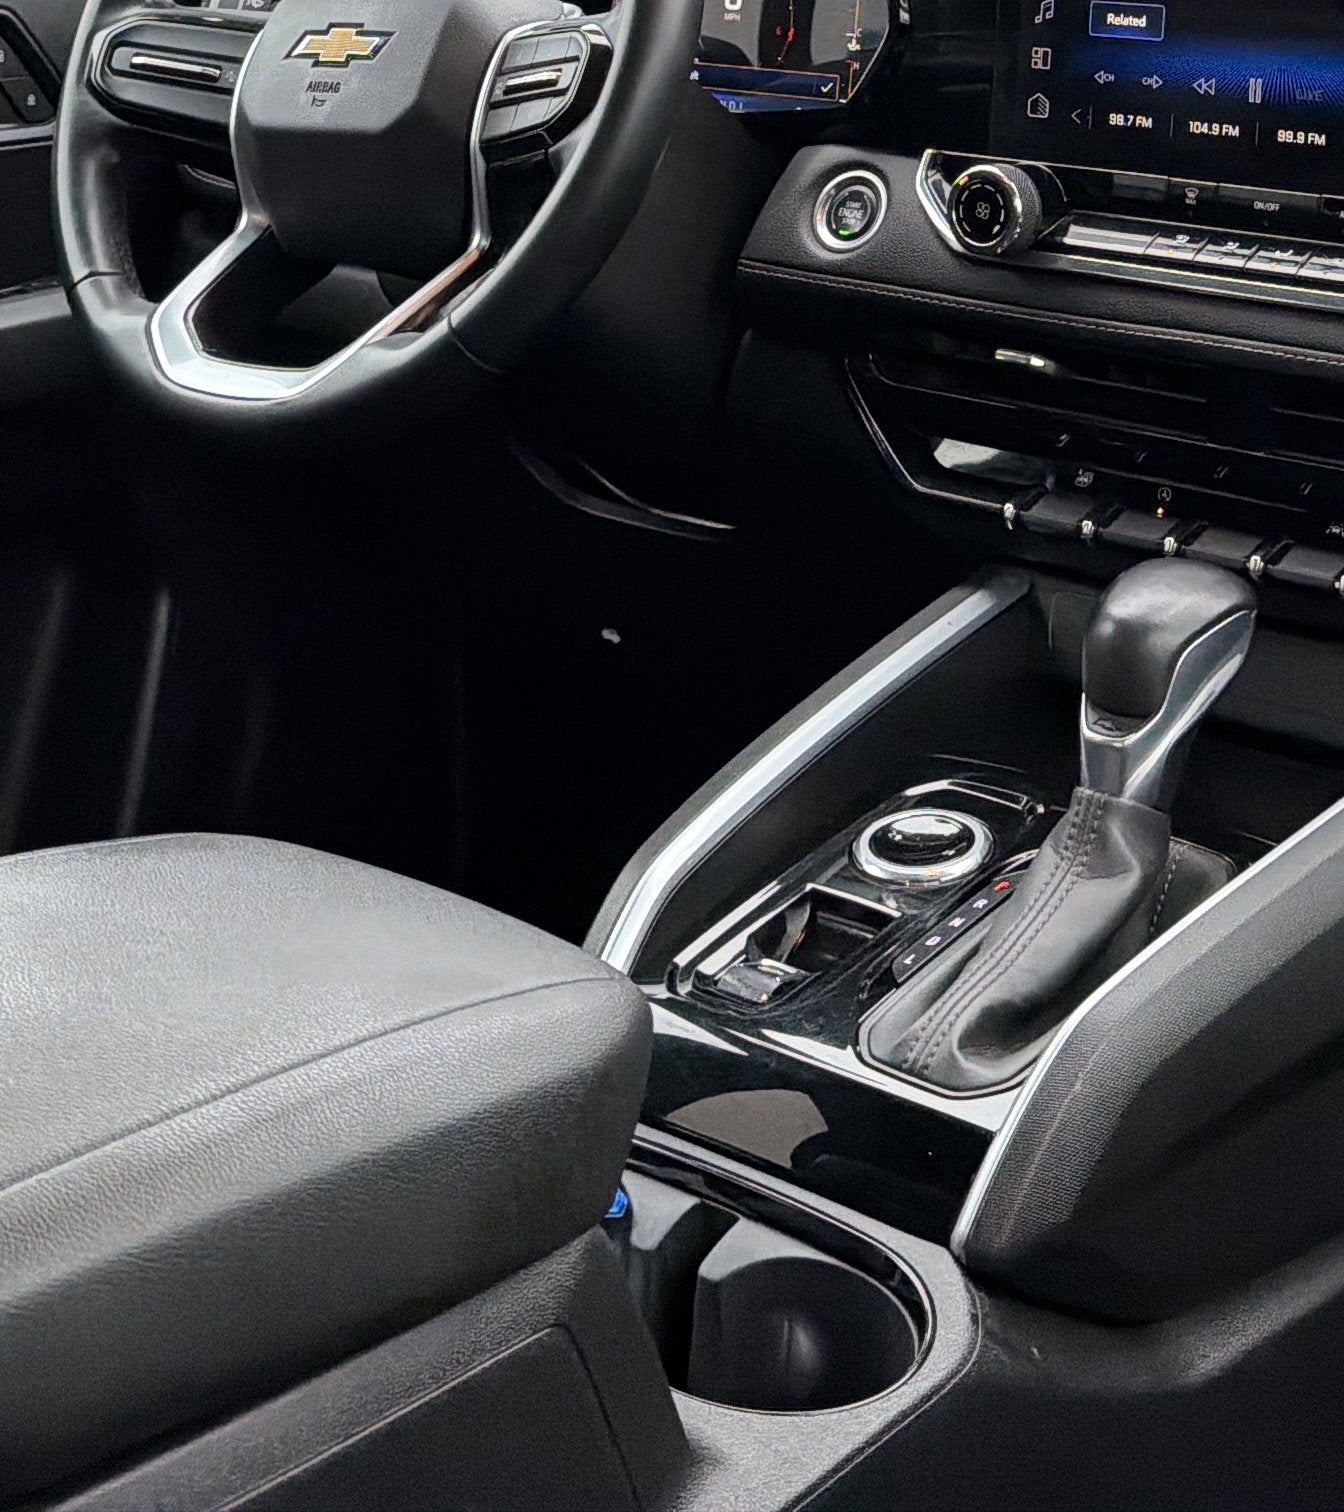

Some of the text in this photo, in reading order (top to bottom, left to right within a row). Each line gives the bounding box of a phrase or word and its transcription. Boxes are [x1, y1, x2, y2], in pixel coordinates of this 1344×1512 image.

[723, 12, 741, 22] MPH
[1106, 12, 1147, 28] Related
[305, 80, 342, 94] AIRBAG
[1109, 113, 1153, 129] 98.7 FM
[1188, 120, 1240, 137] 104.9 FM
[1307, 132, 1326, 147] FM
[1253, 200, 1281, 212] ON/OFF
